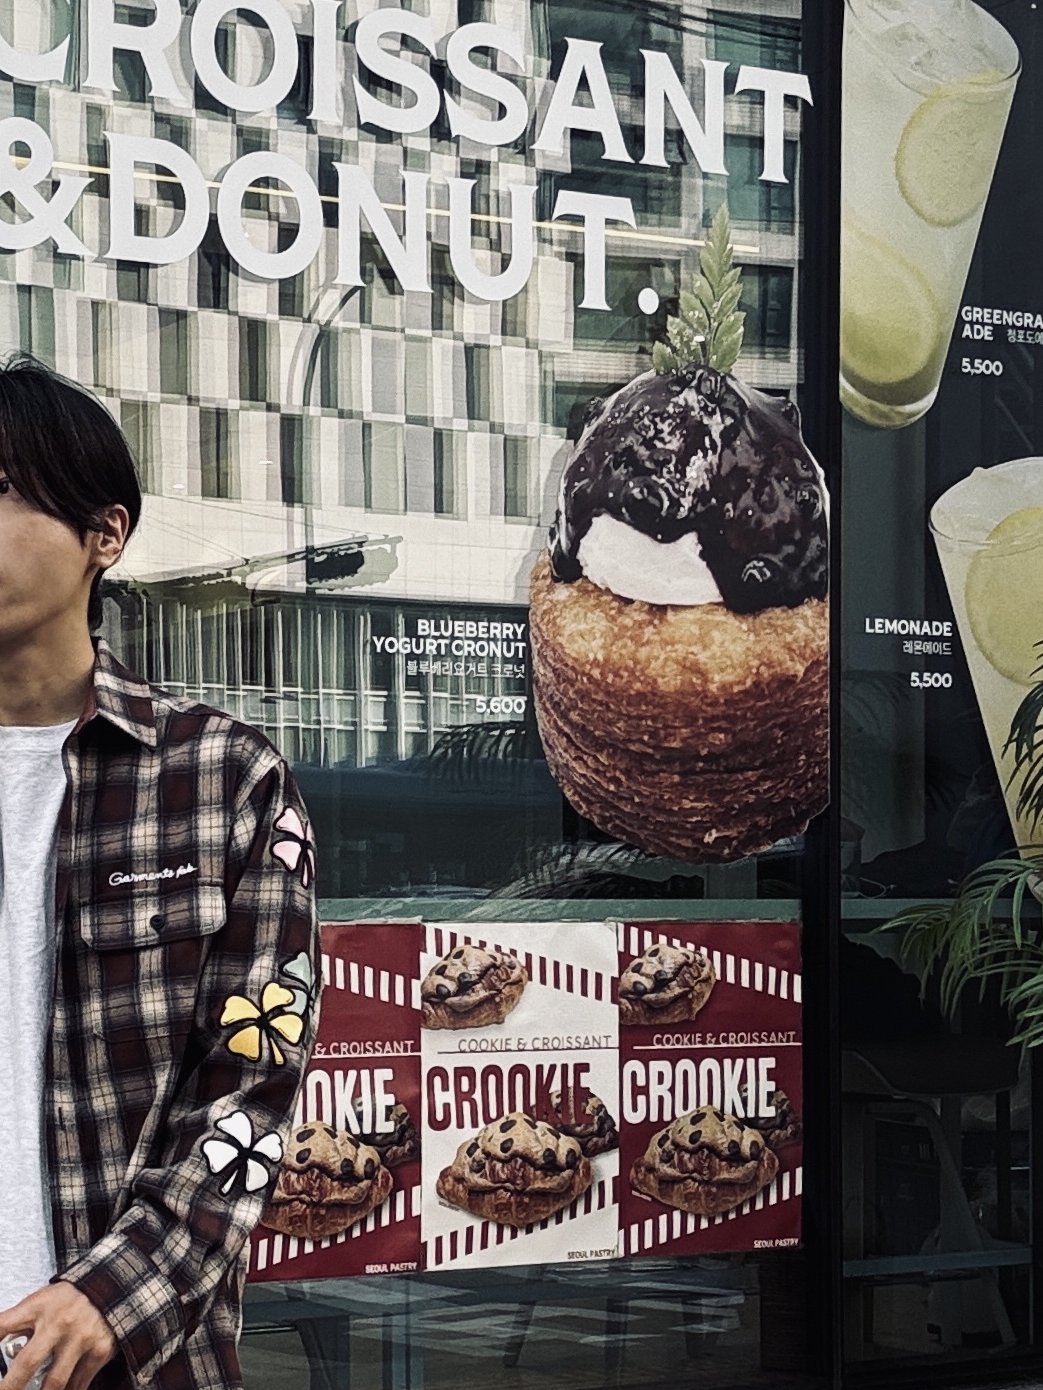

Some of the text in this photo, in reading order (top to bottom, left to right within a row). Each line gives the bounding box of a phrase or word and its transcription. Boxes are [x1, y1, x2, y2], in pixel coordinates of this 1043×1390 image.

[961, 306, 1043, 329] GREENGRA
[962, 323, 994, 341] ADE
[961, 357, 1003, 376] 5,500
[417, 618, 526, 640] BLUEBERRY
[865, 617, 953, 637] LEMONADE
[372, 636, 527, 659] YOGURT CRONUT
[491, 664, 526, 679] 크로넛
[910, 671, 953, 689] 5,500
[475, 697, 527, 715] 5,600
[315, 1040, 415, 1056] & CROISSANT
[458, 1034, 613, 1052] COOKIE & CROISSANT
[653, 1031, 797, 1047] COOKIE & CROISSANT
[426, 1063, 596, 1132] CROOKIE
[623, 1057, 777, 1125] CROOKIE
[774, 1237, 799, 1248] PASTRY
[589, 1248, 615, 1258] PASTRY
[390, 1262, 418, 1273] PASTRY
